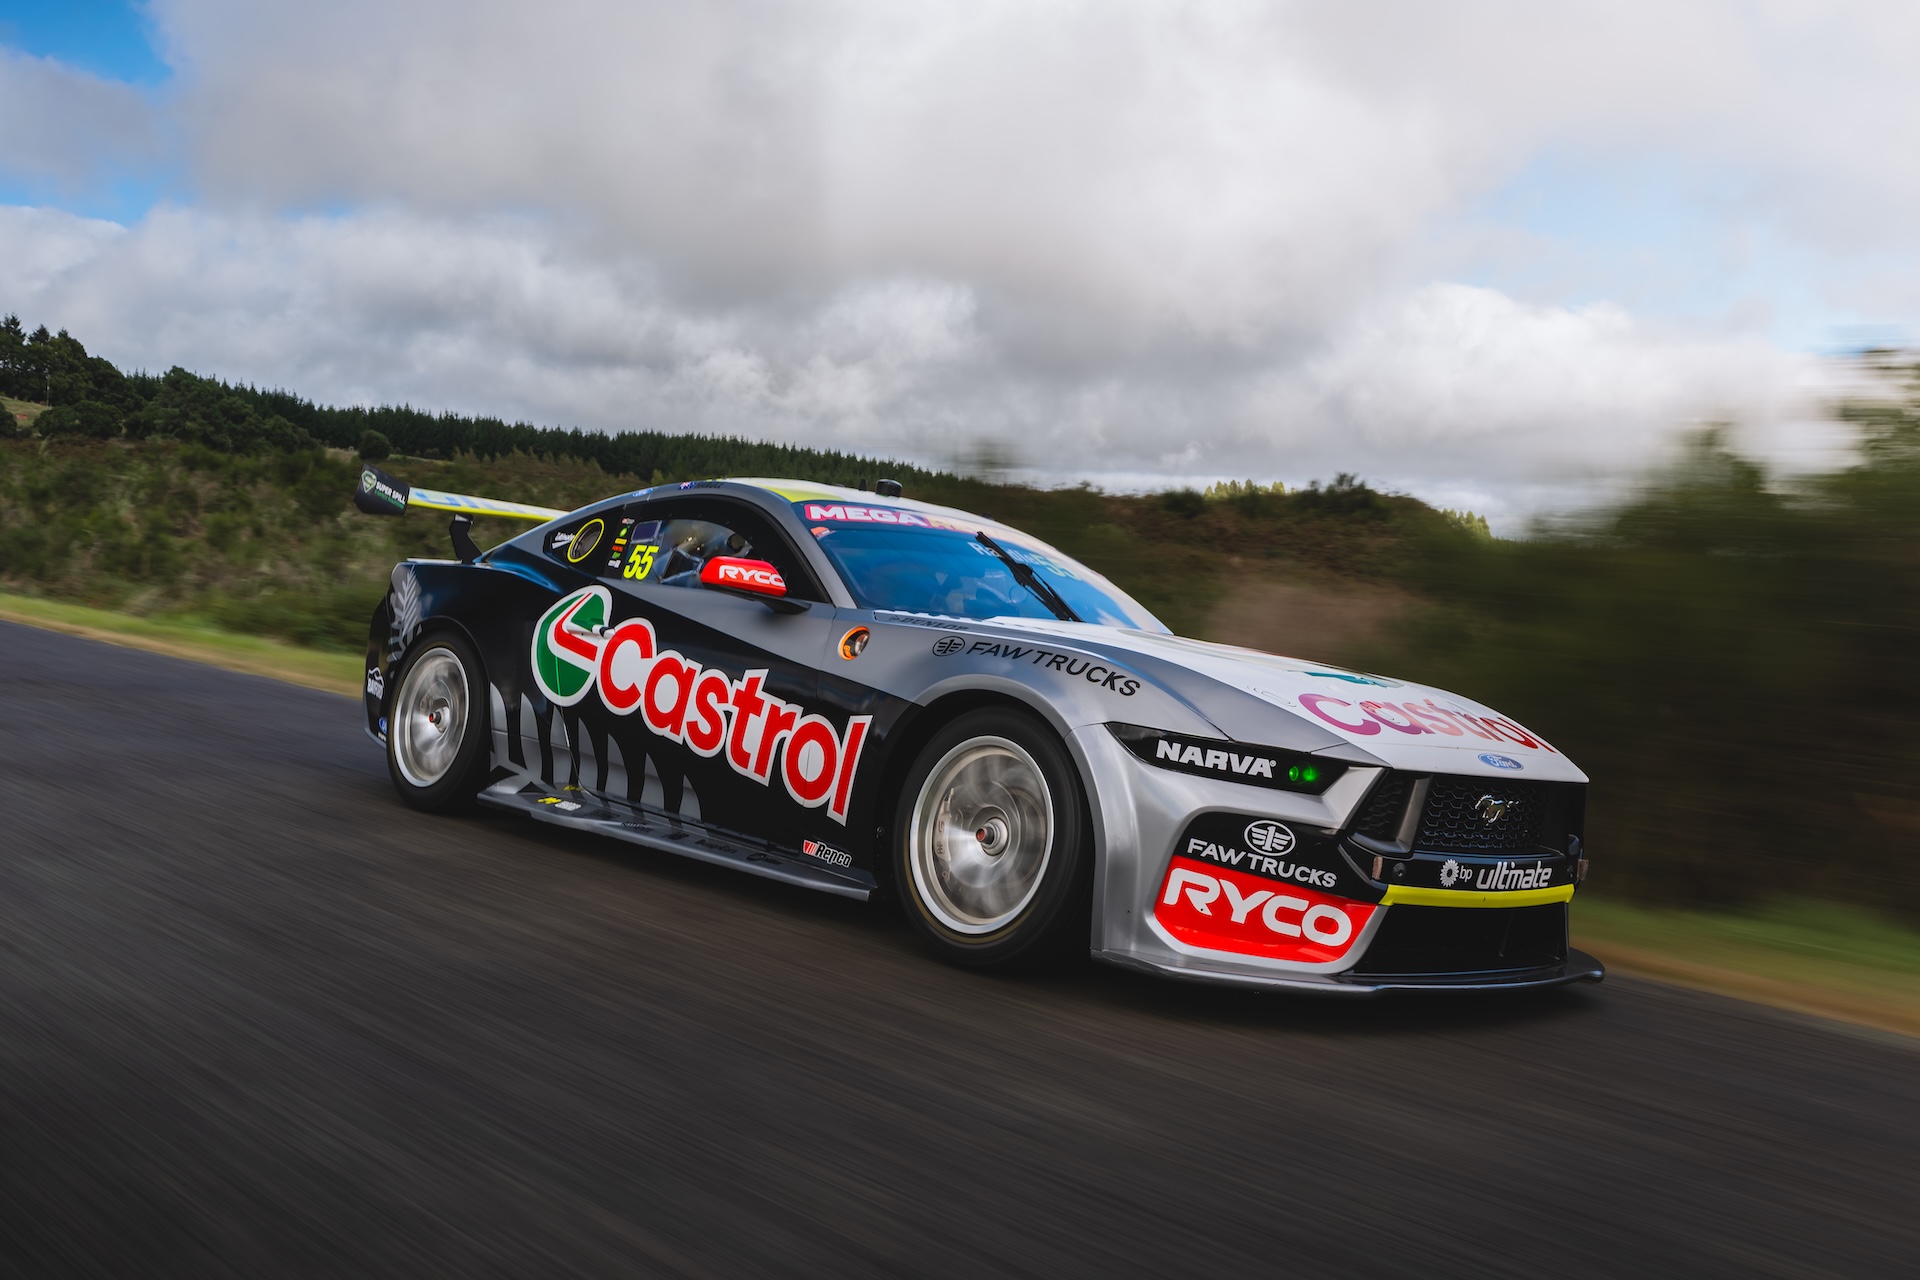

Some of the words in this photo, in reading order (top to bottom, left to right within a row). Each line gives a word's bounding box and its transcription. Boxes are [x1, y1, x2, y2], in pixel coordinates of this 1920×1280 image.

[376, 481, 392, 497] SUPER
[808, 503, 929, 528] MEGA
[623, 544, 660, 580] 55
[718, 564, 787, 588] RYCO
[900, 617, 970, 631] DUNLOP
[966, 641, 1034, 660] FAW
[1032, 650, 1141, 697] TRUCKS
[597, 619, 871, 824] Castrol
[1298, 693, 1557, 754] Castrol
[1486, 755, 1518, 769] Ford
[815, 841, 852, 868] Repco
[1187, 838, 1246, 866] FAW
[1247, 853, 1338, 888] TRUCKS
[1459, 865, 1473, 882] bp
[1476, 860, 1552, 890] ultimate
[1163, 867, 1353, 947] RYCO
